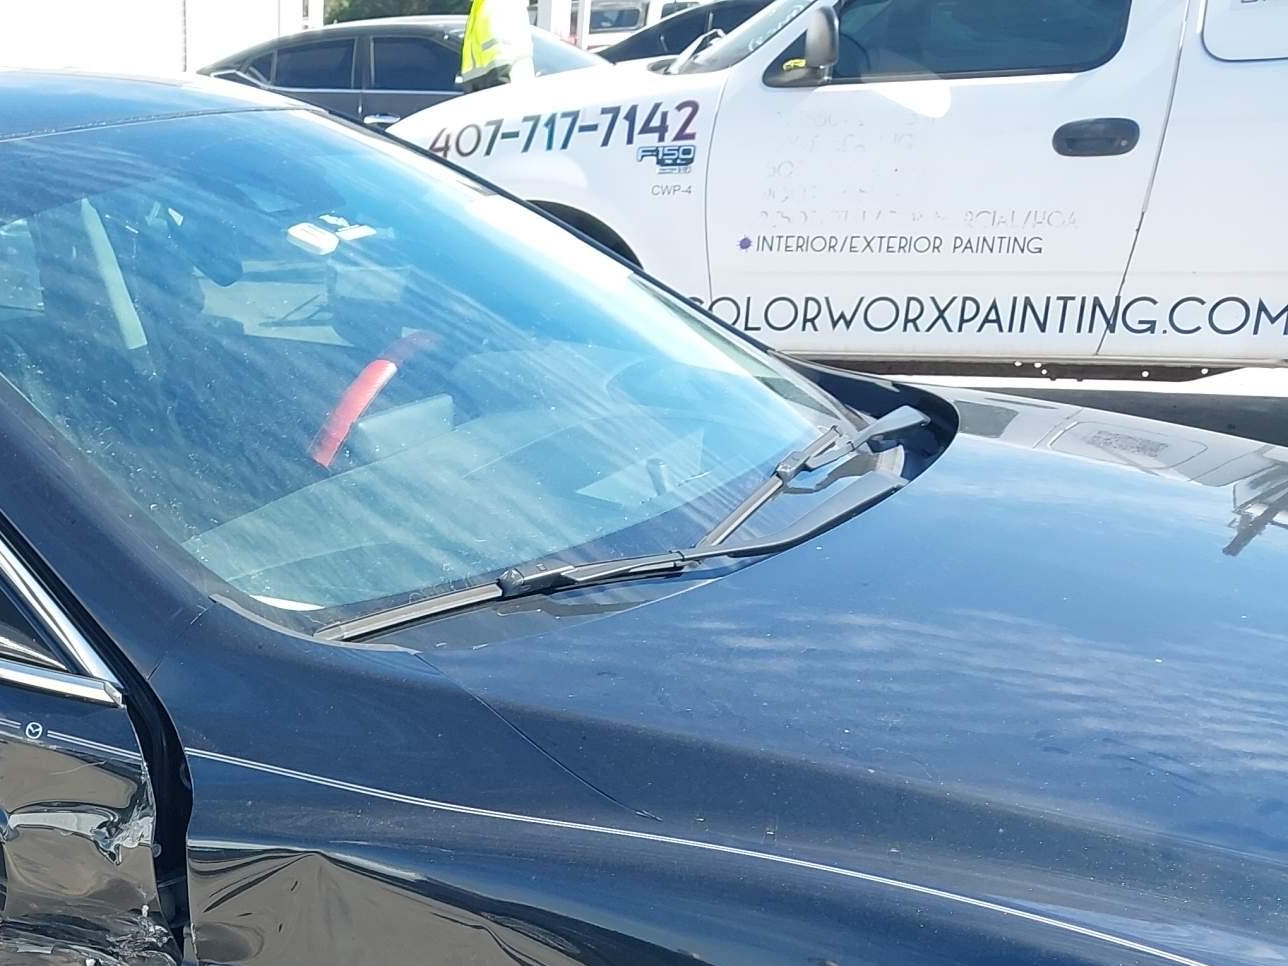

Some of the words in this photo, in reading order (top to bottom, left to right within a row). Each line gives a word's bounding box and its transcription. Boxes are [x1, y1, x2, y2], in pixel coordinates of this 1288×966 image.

[429, 100, 700, 158] 407-717-7142
[651, 184, 693, 196] CWP-4
[755, 235, 943, 254] INTERIOR/EXTERIOR
[952, 235, 1044, 255] PAINTING
[688, 296, 1288, 335] OLORWORXPAINTING.COM
